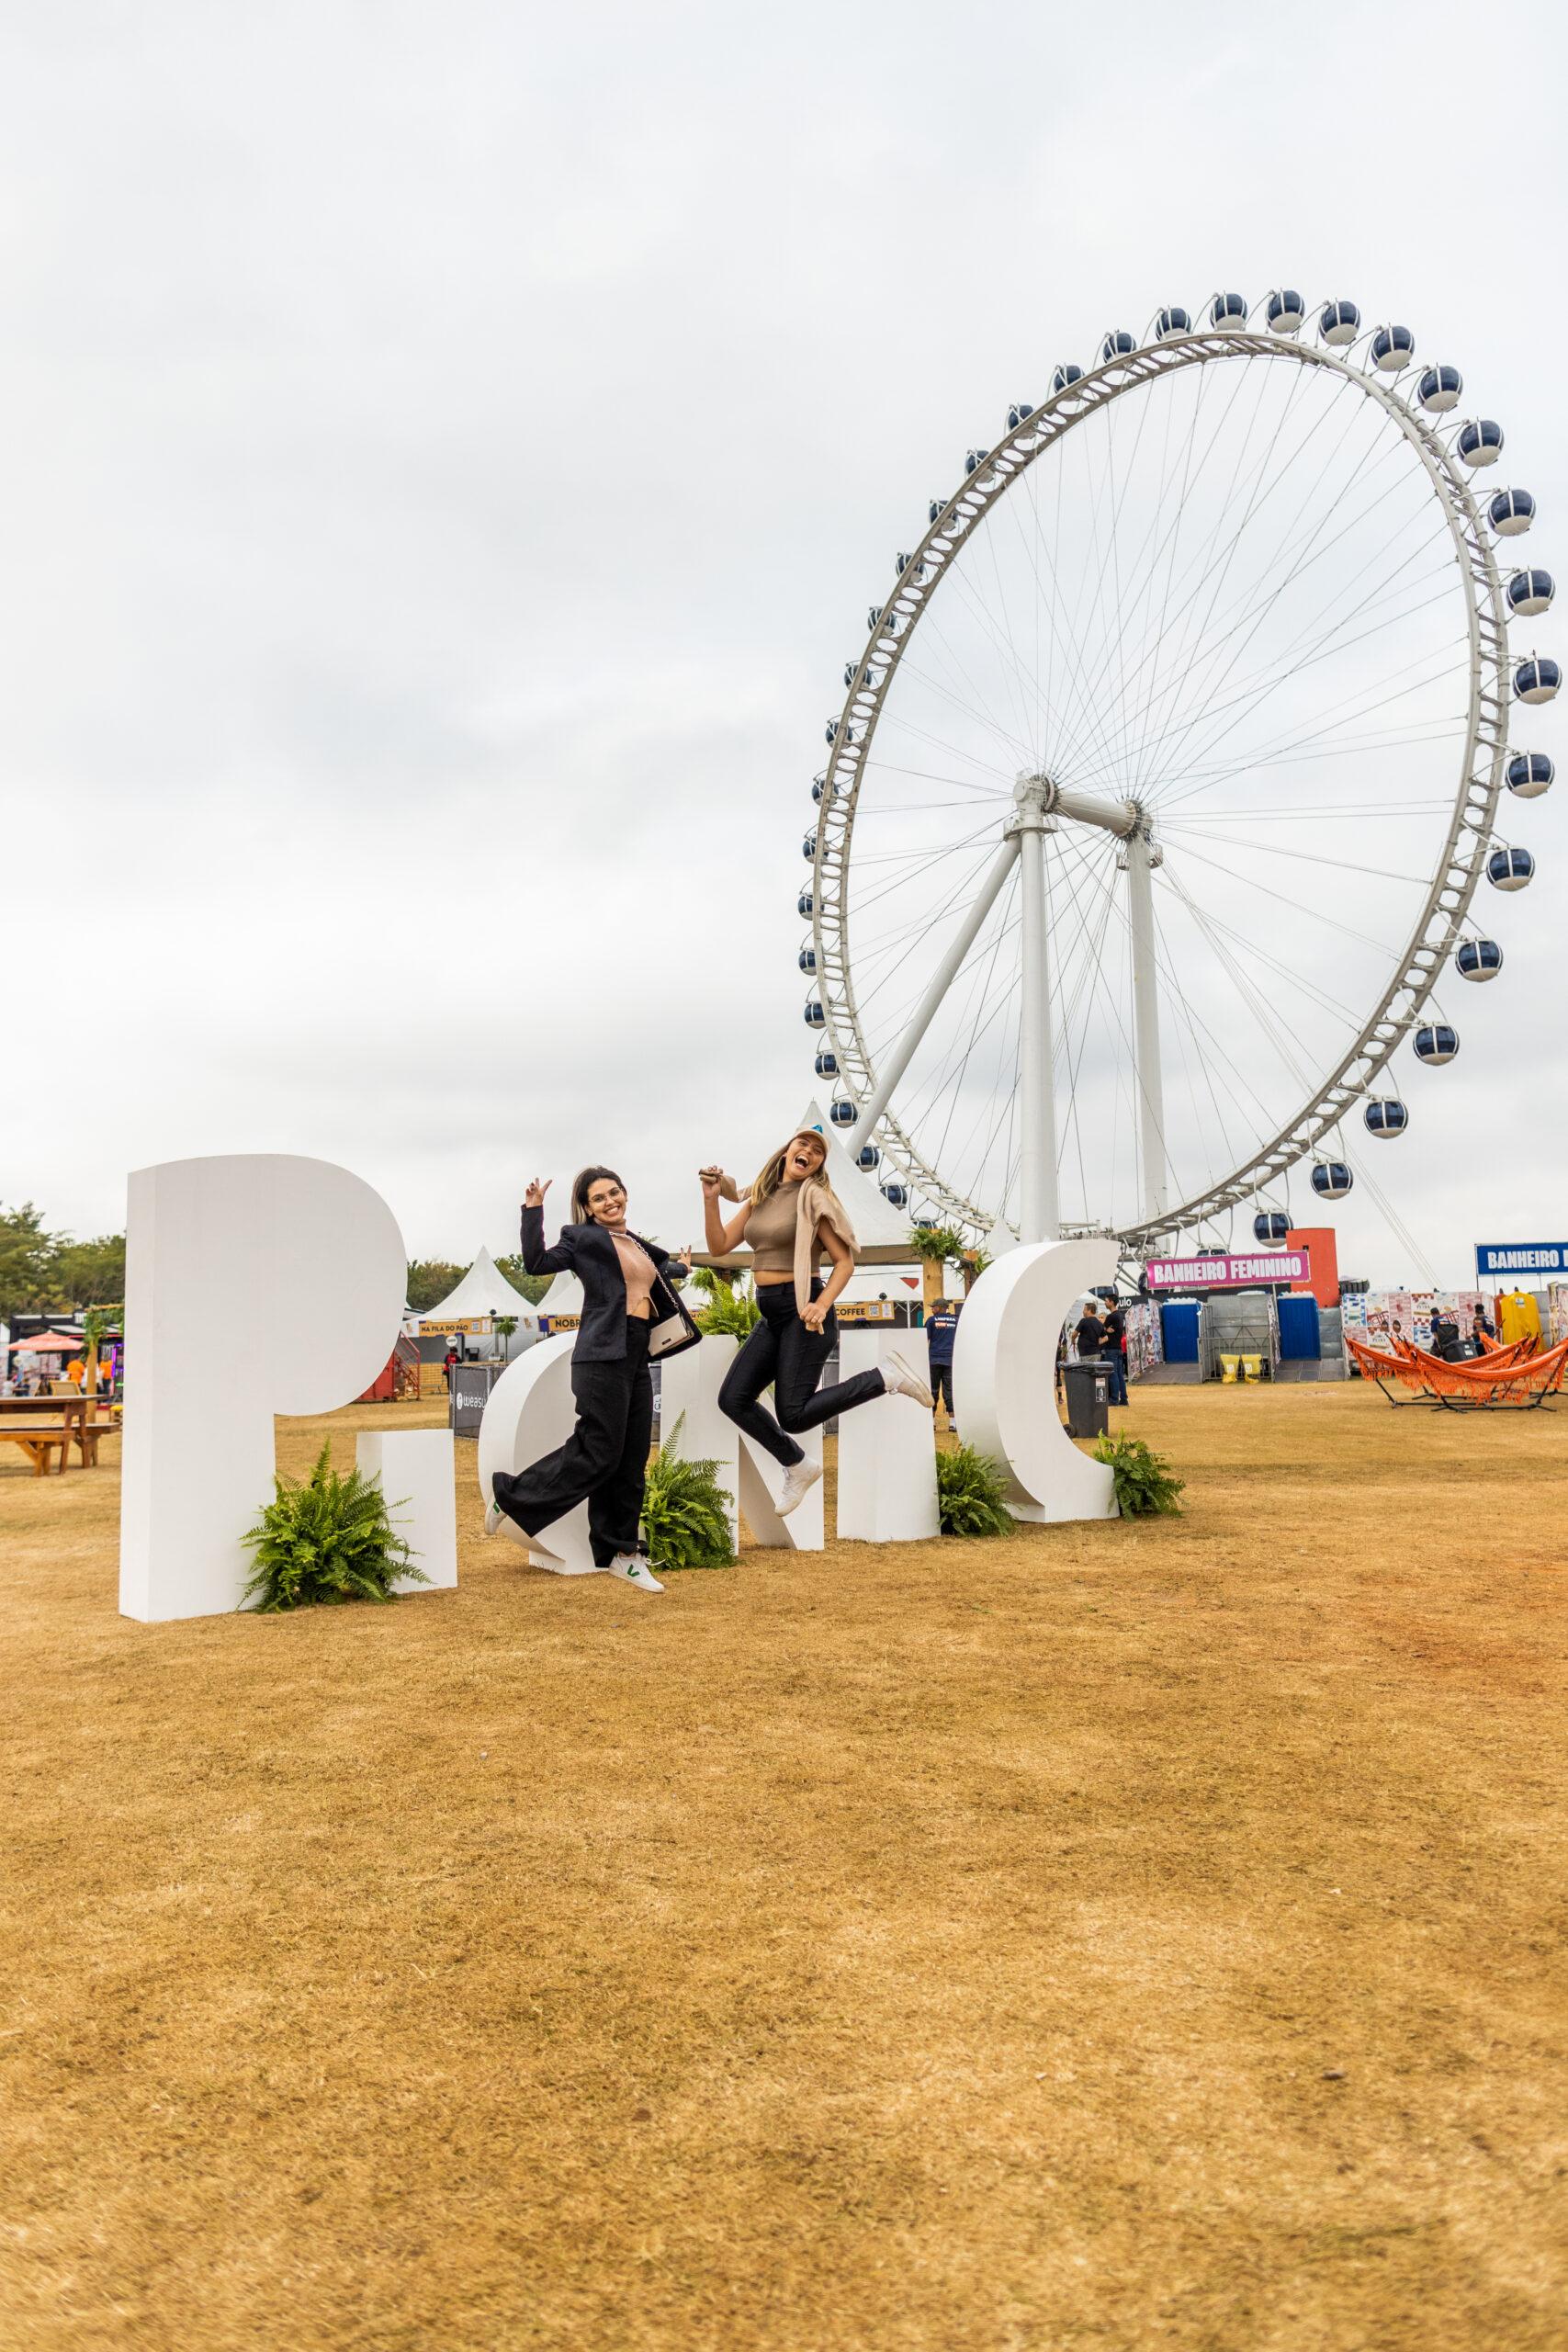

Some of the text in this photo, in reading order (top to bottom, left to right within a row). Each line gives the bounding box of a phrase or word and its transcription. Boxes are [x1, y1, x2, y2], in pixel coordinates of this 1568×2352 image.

[1154, 1256, 1302, 1283] BANHEIRO FEMININO
[1487, 1250, 1560, 1270] BANHEIRO
[835, 1307, 865, 1316] COFFEE
